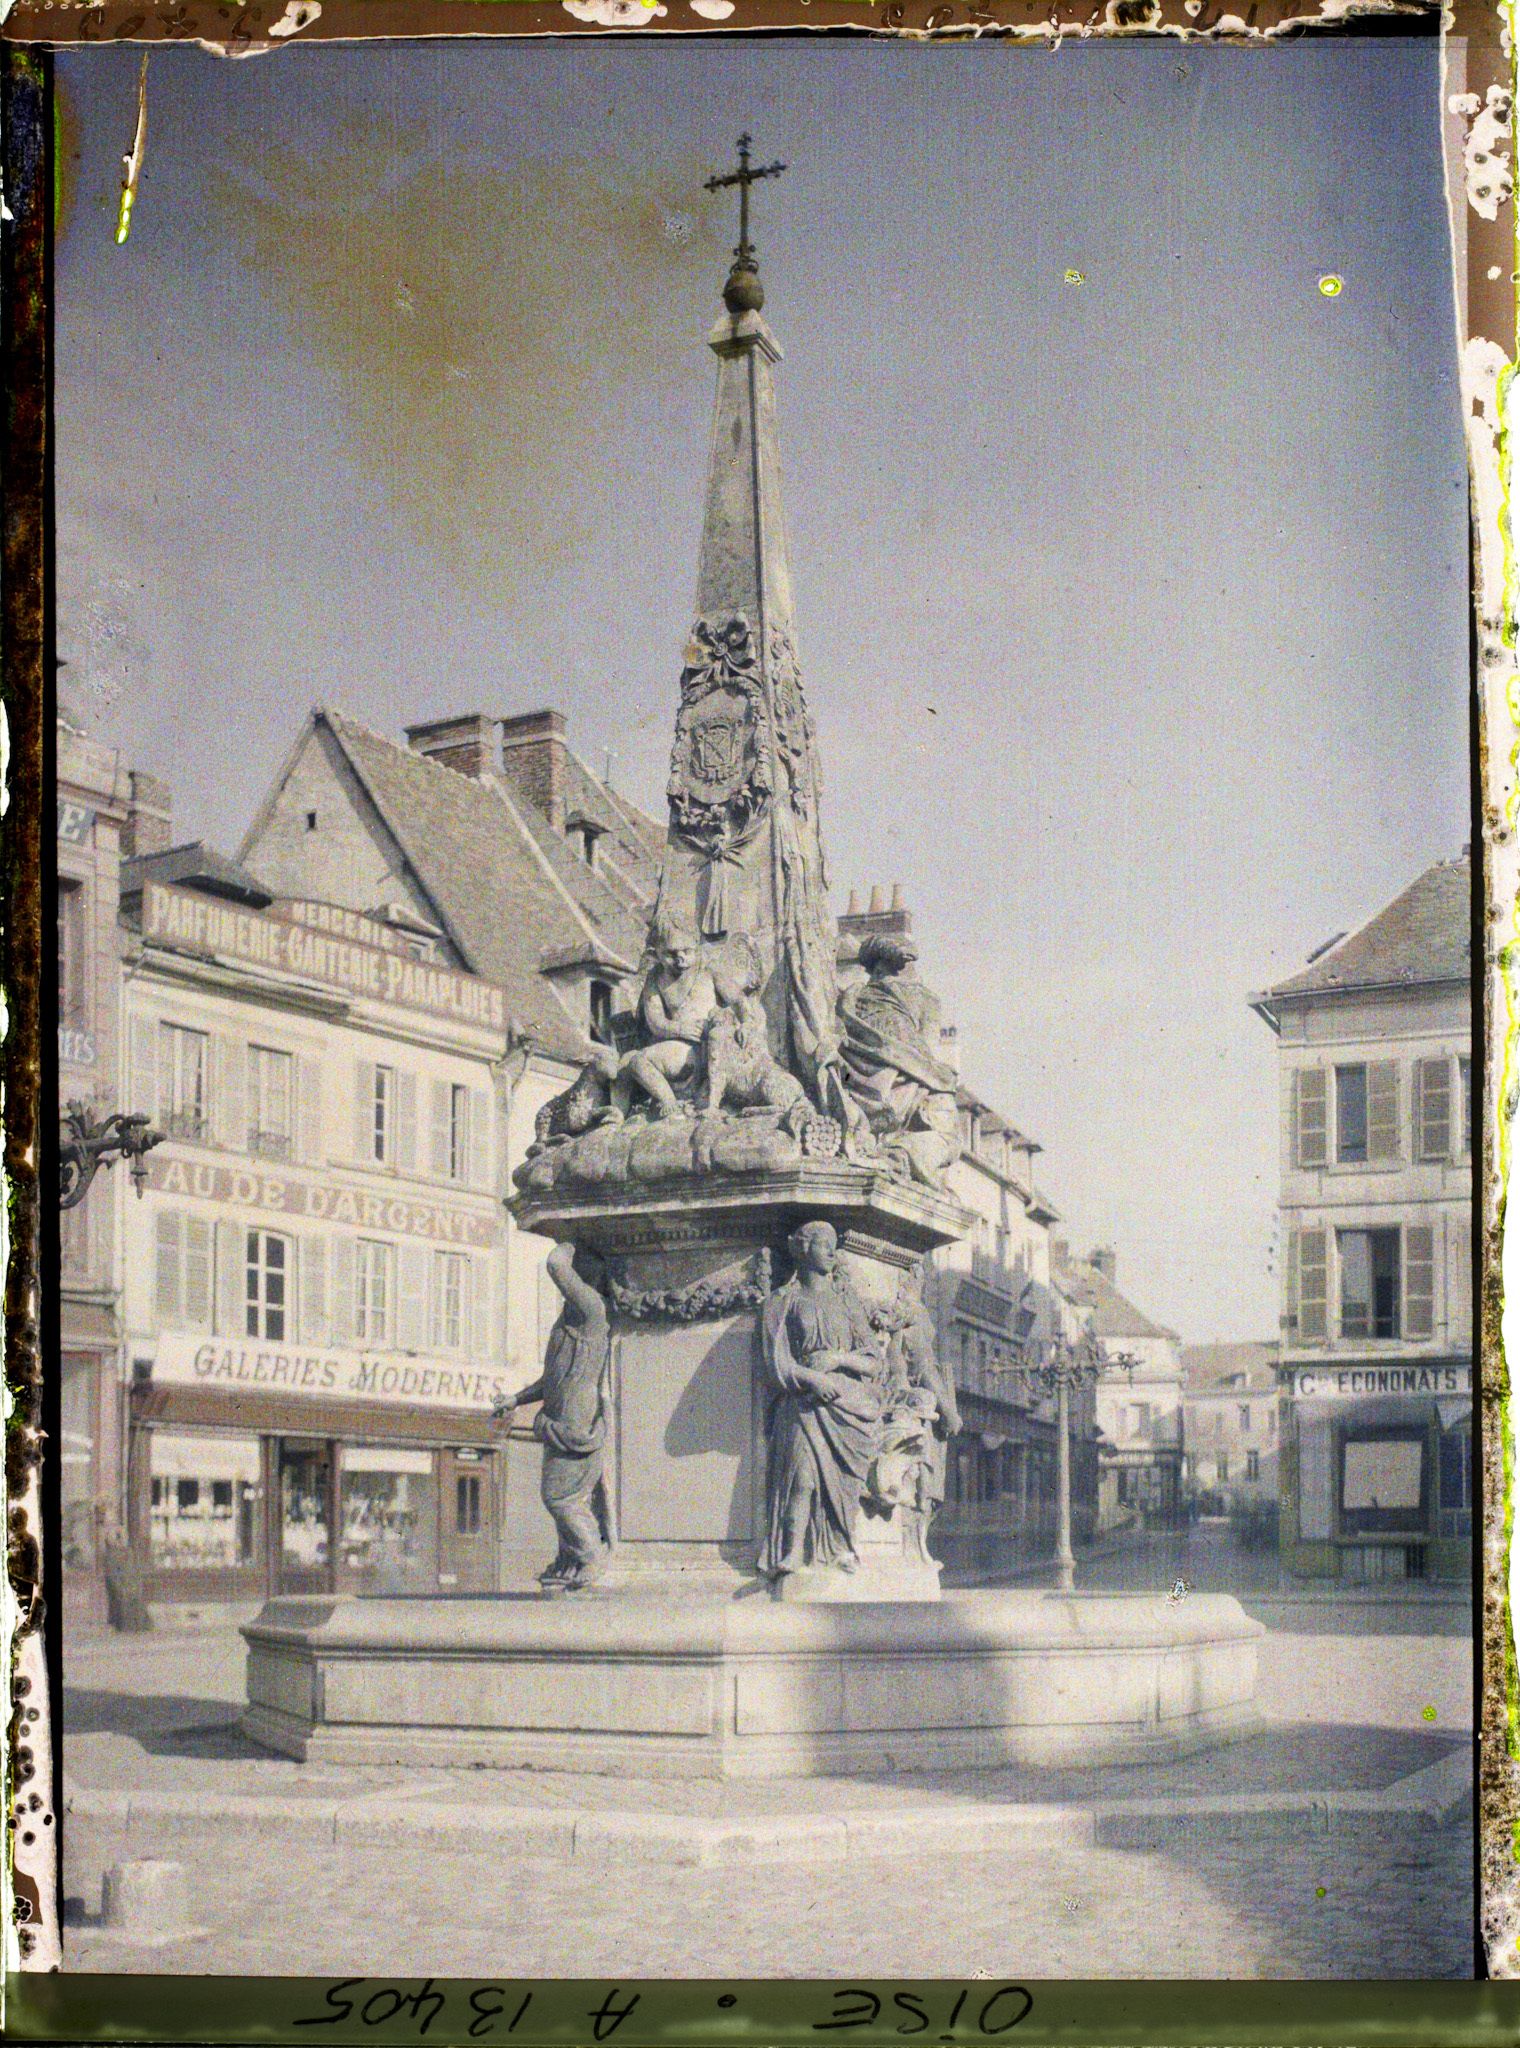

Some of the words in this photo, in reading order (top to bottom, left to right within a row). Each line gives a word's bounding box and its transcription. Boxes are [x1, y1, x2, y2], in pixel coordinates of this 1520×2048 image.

[160, 1161, 217, 1198] AU
[305, 1186, 478, 1243] D'ARGENT
[193, 1345, 339, 1389] GALERIES
[348, 1359, 506, 1399] MODERNES
[1337, 1367, 1457, 1393] ECONOMATS
[588, 1988, 641, 2041] A
